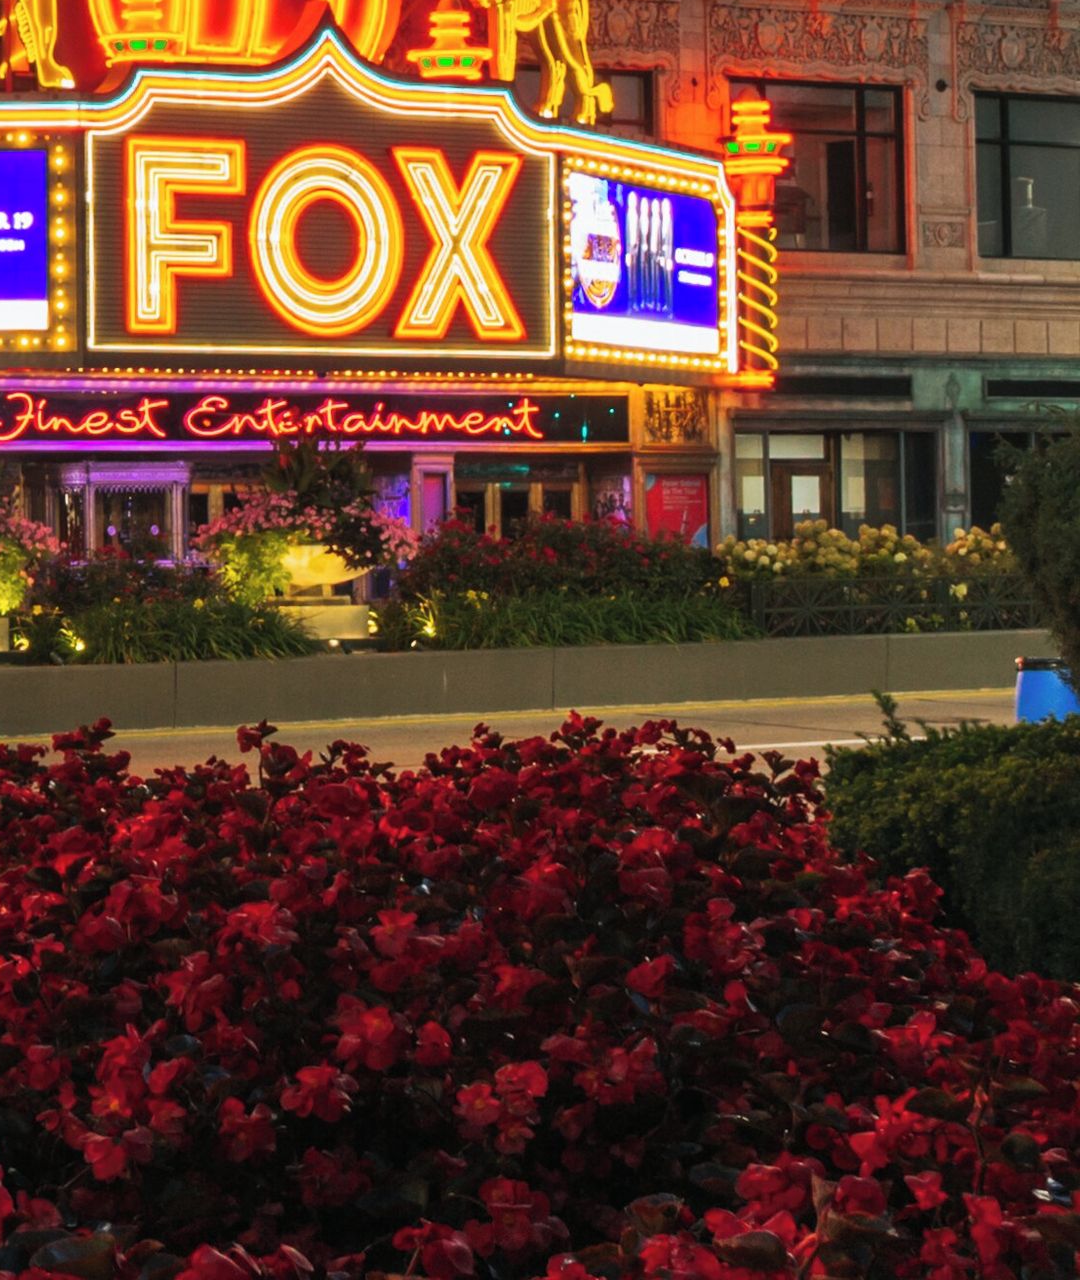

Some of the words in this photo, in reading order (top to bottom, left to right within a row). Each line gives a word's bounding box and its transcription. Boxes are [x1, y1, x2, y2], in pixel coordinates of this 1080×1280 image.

[13, 211, 34, 230] 19
[127, 137, 526, 339] FOX
[184, 395, 543, 439] Entertainment
